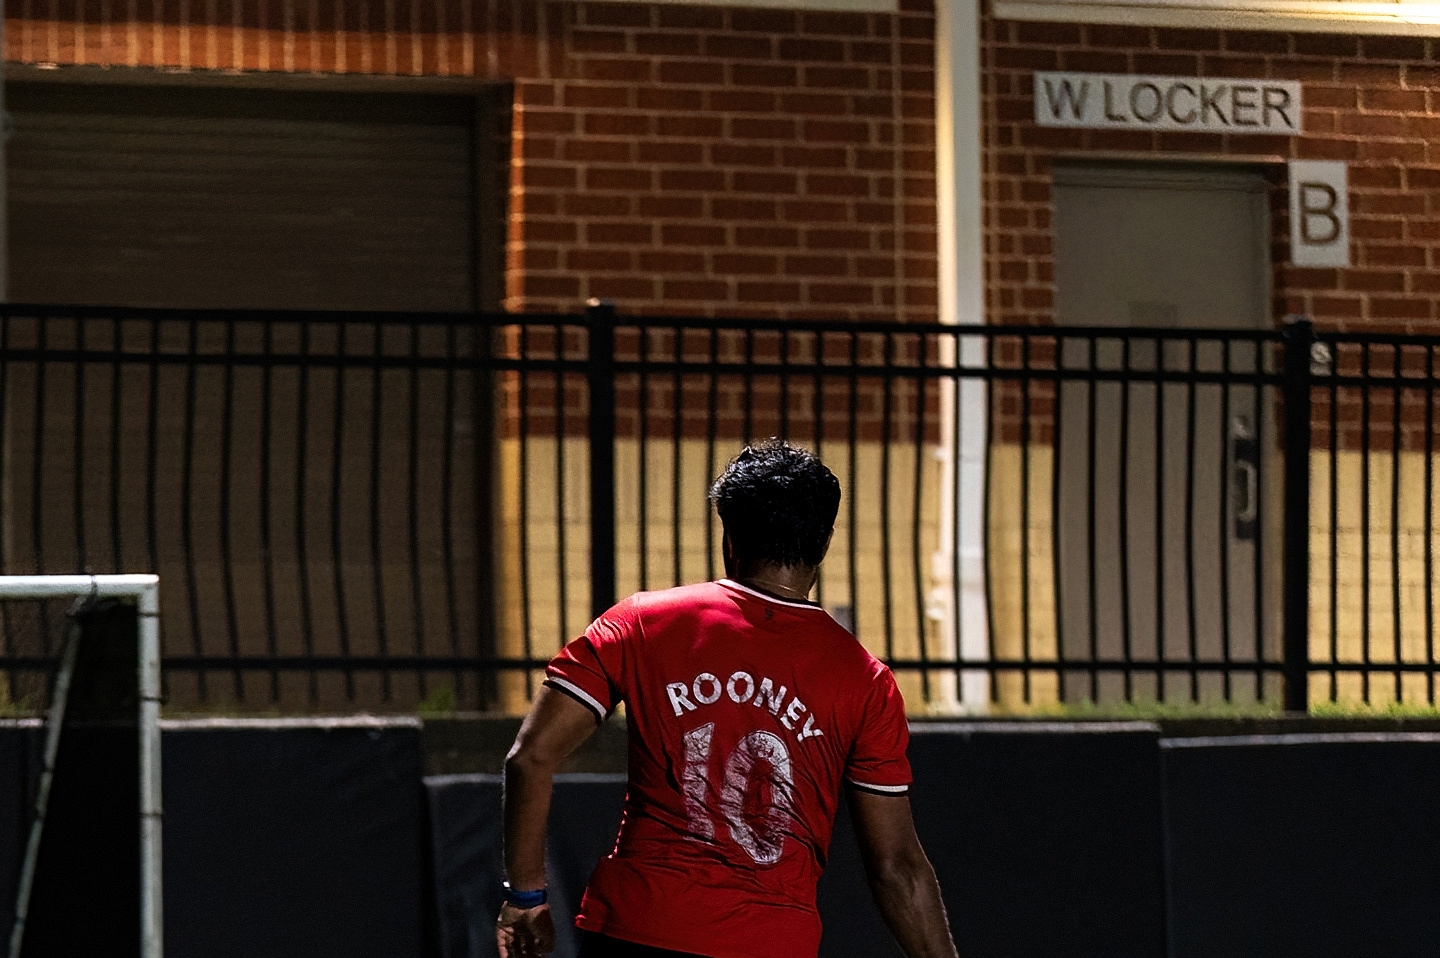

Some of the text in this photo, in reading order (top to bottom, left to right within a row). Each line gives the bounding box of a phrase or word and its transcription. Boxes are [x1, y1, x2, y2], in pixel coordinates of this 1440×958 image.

[1043, 79, 1294, 128] W LOCKER
[1300, 181, 1341, 246] B
[666, 671, 824, 743] ROONEY
[682, 722, 795, 865] 10
